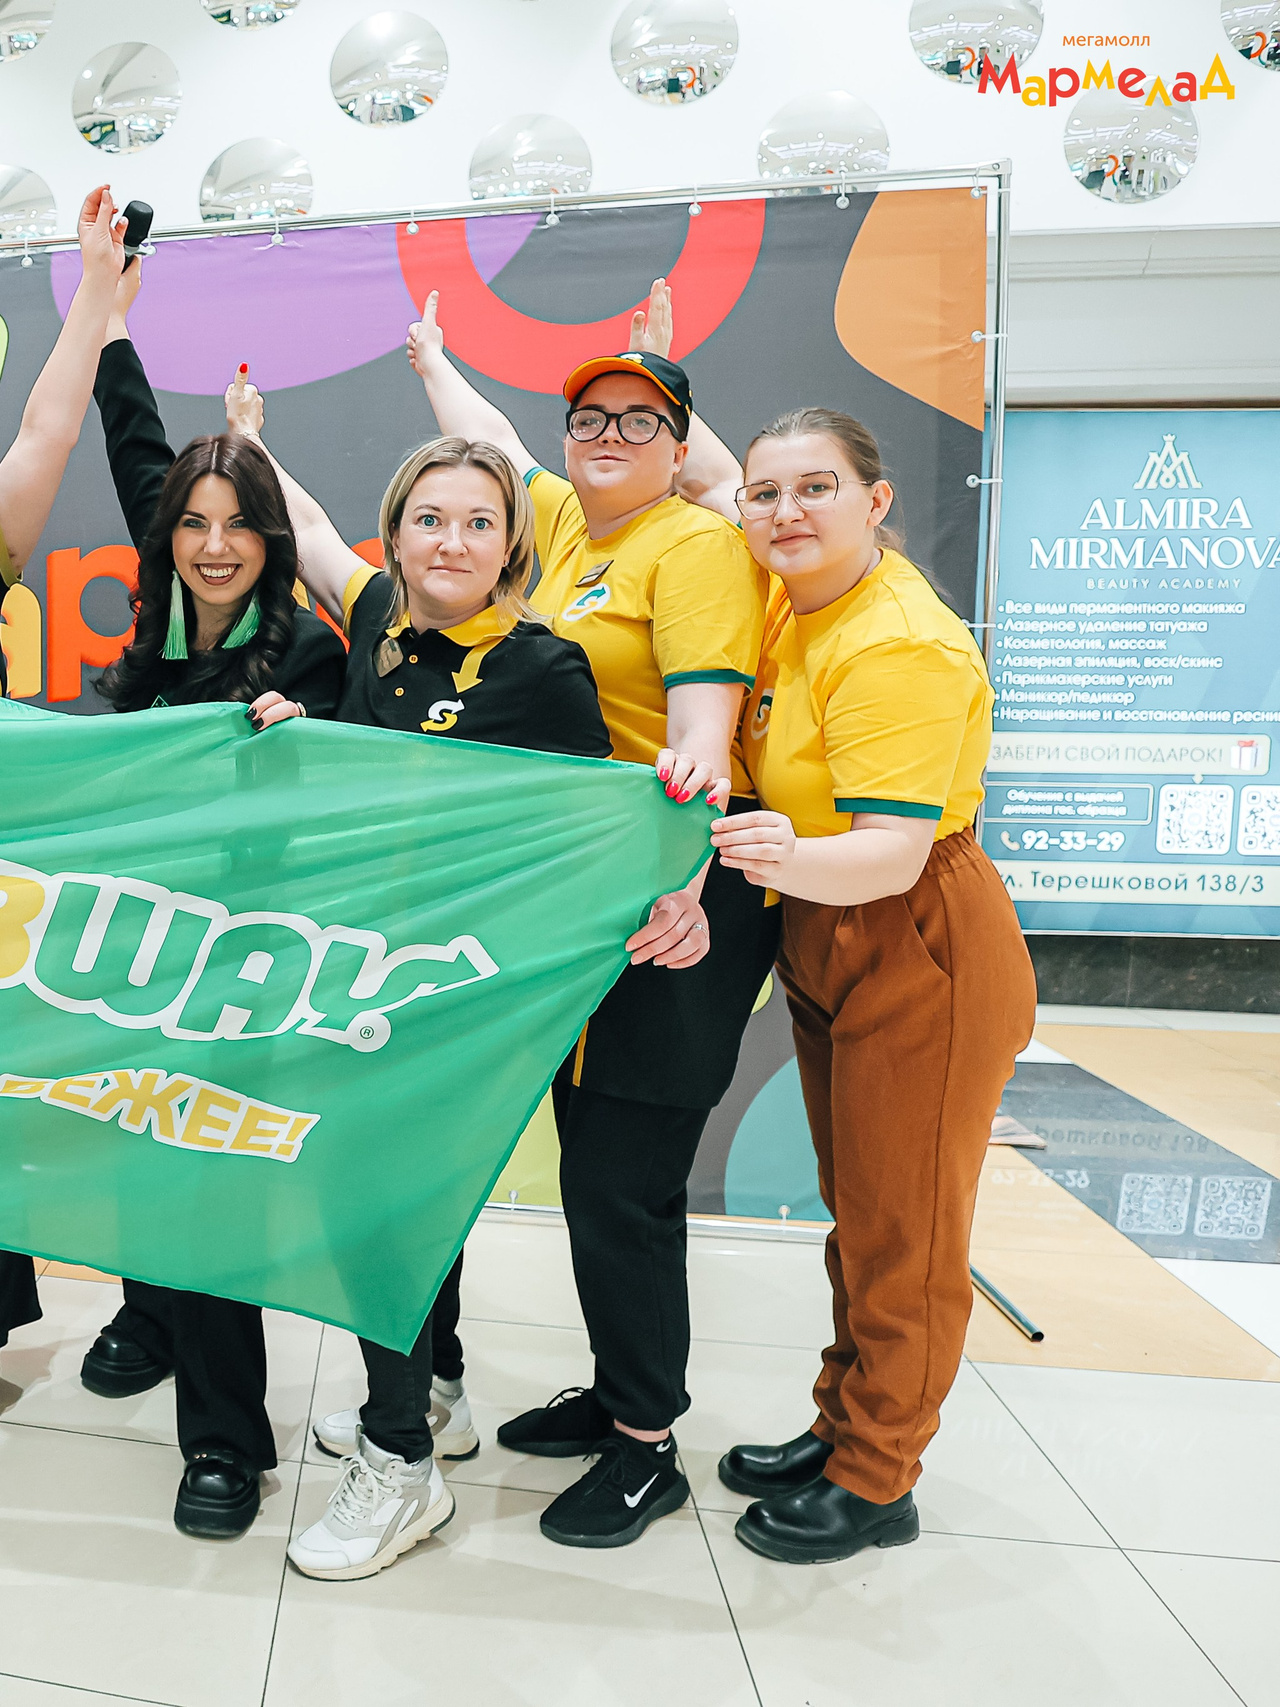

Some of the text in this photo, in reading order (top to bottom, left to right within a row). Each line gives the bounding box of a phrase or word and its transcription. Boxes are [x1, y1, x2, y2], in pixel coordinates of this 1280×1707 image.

[1079, 496, 1253, 531] ALMIRA
[1086, 577, 1242, 590] BEAUTY ACADEMY
[1005, 600, 1246, 617] Все виды перманентного макияжа
[1004, 618, 1208, 635] Лазерное удаление татуажа
[1003, 636, 1167, 651] Косметология, массаж
[1002, 653, 1223, 670] Лазерная эпиляция, воск/скинс
[1001, 671, 1174, 688] Парикмахерские услуги
[1000, 689, 1136, 706] Маникюр/педикюр
[1000, 706, 1101, 723] Наращивание
[1102, 710, 1113, 721] и
[1114, 710, 1231, 722] восстановление
[991, 744, 1223, 763] ЗАБЕРИ СВОЙ ПОДАРОК!
[1021, 828, 1126, 852] 92-33-29
[1031, 870, 1188, 892] Терешковой
[1196, 874, 1265, 895] 138/3
